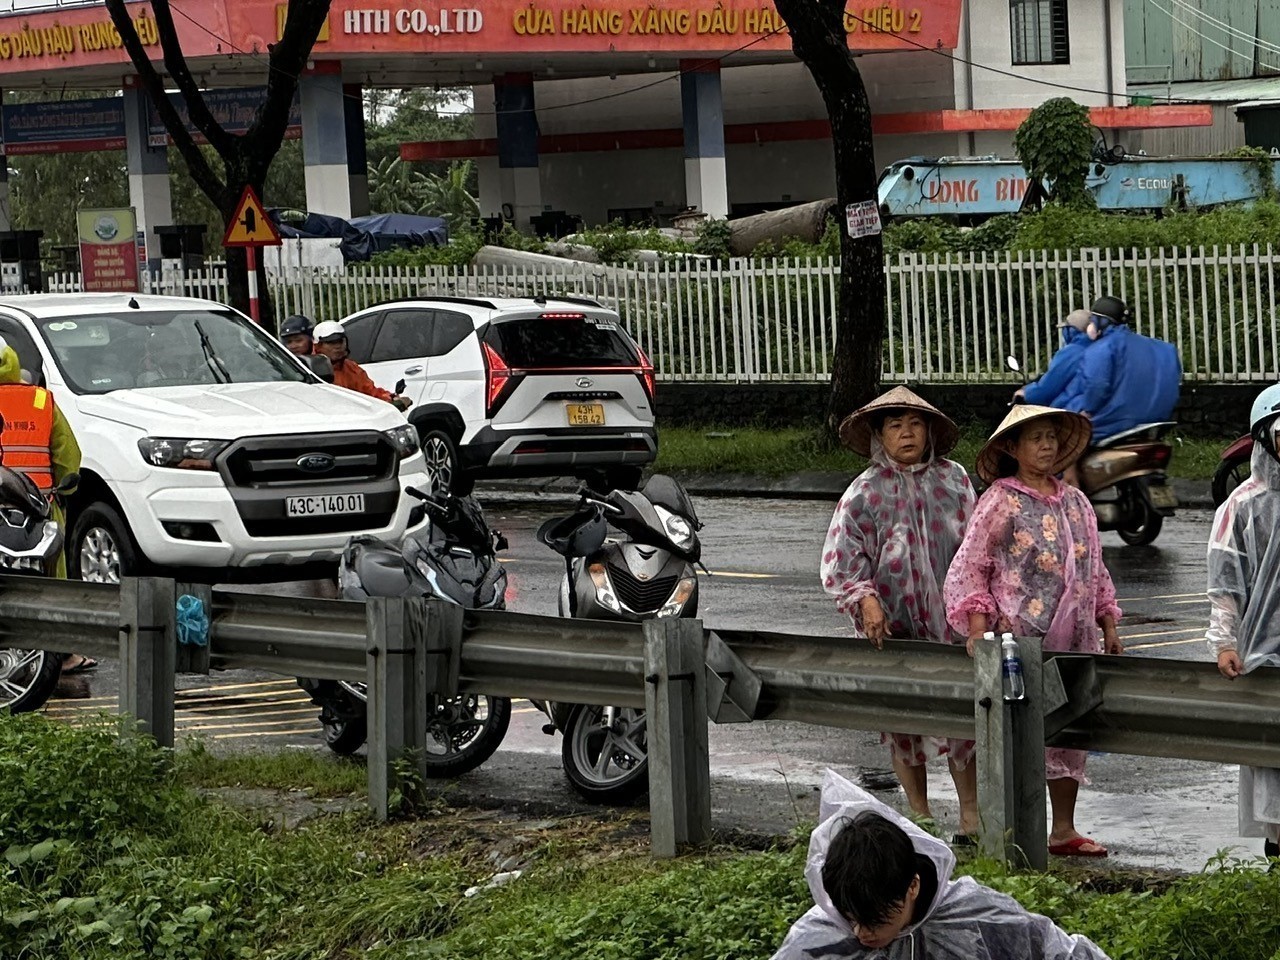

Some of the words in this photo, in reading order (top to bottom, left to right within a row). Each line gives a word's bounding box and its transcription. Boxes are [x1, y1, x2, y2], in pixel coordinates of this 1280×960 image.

[344, 9, 390, 33] HTH
[513, 3, 555, 34] CỬA
[562, 4, 624, 34] HÀNG
[629, 4, 691, 34] XĂNG
[697, 1, 739, 34] DẦU
[909, 8, 922, 32] 2
[75, 21, 122, 52] TRUNG
[930, 179, 979, 203] LONG
[996, 174, 1031, 201] BÌN
[578, 405, 593, 414] 43H
[290, 495, 362, 514] 43C-140.01
